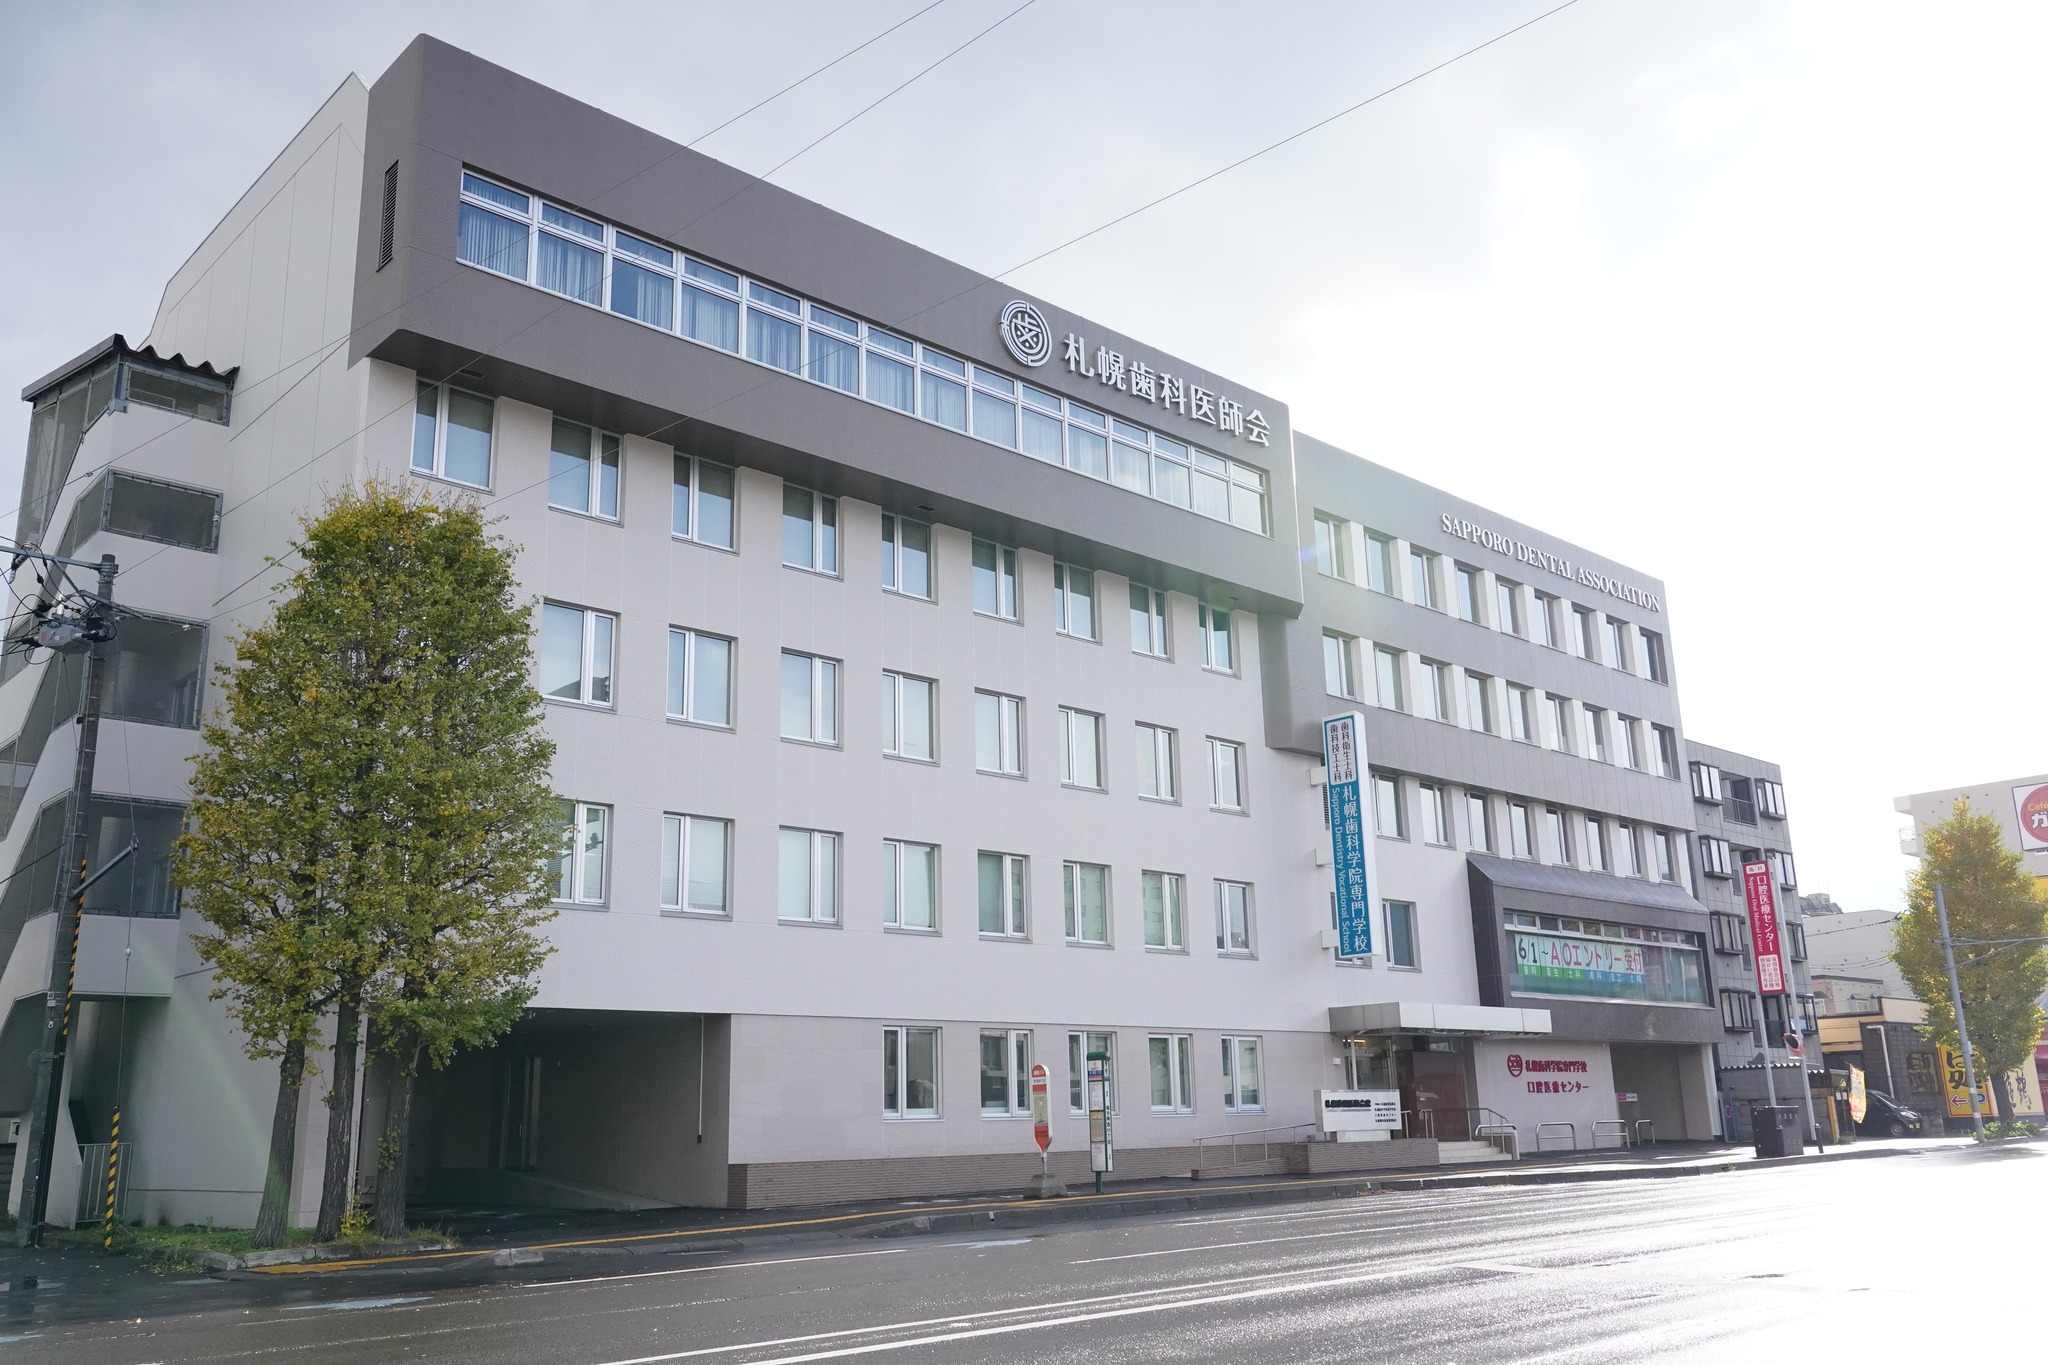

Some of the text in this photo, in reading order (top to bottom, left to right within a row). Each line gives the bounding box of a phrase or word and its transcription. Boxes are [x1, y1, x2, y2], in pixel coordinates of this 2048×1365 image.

[1063, 332, 1270, 447] 札幌歯科医師会
[1441, 513, 1661, 612] SAPPORO DENTAL ASSOCIATION
[1331, 787, 1351, 953] Sapporo Dentistry Vocational School
[1342, 785, 1368, 952] 札幌歯科学院専門学校
[1757, 875, 1774, 952] 口腔医療センター
